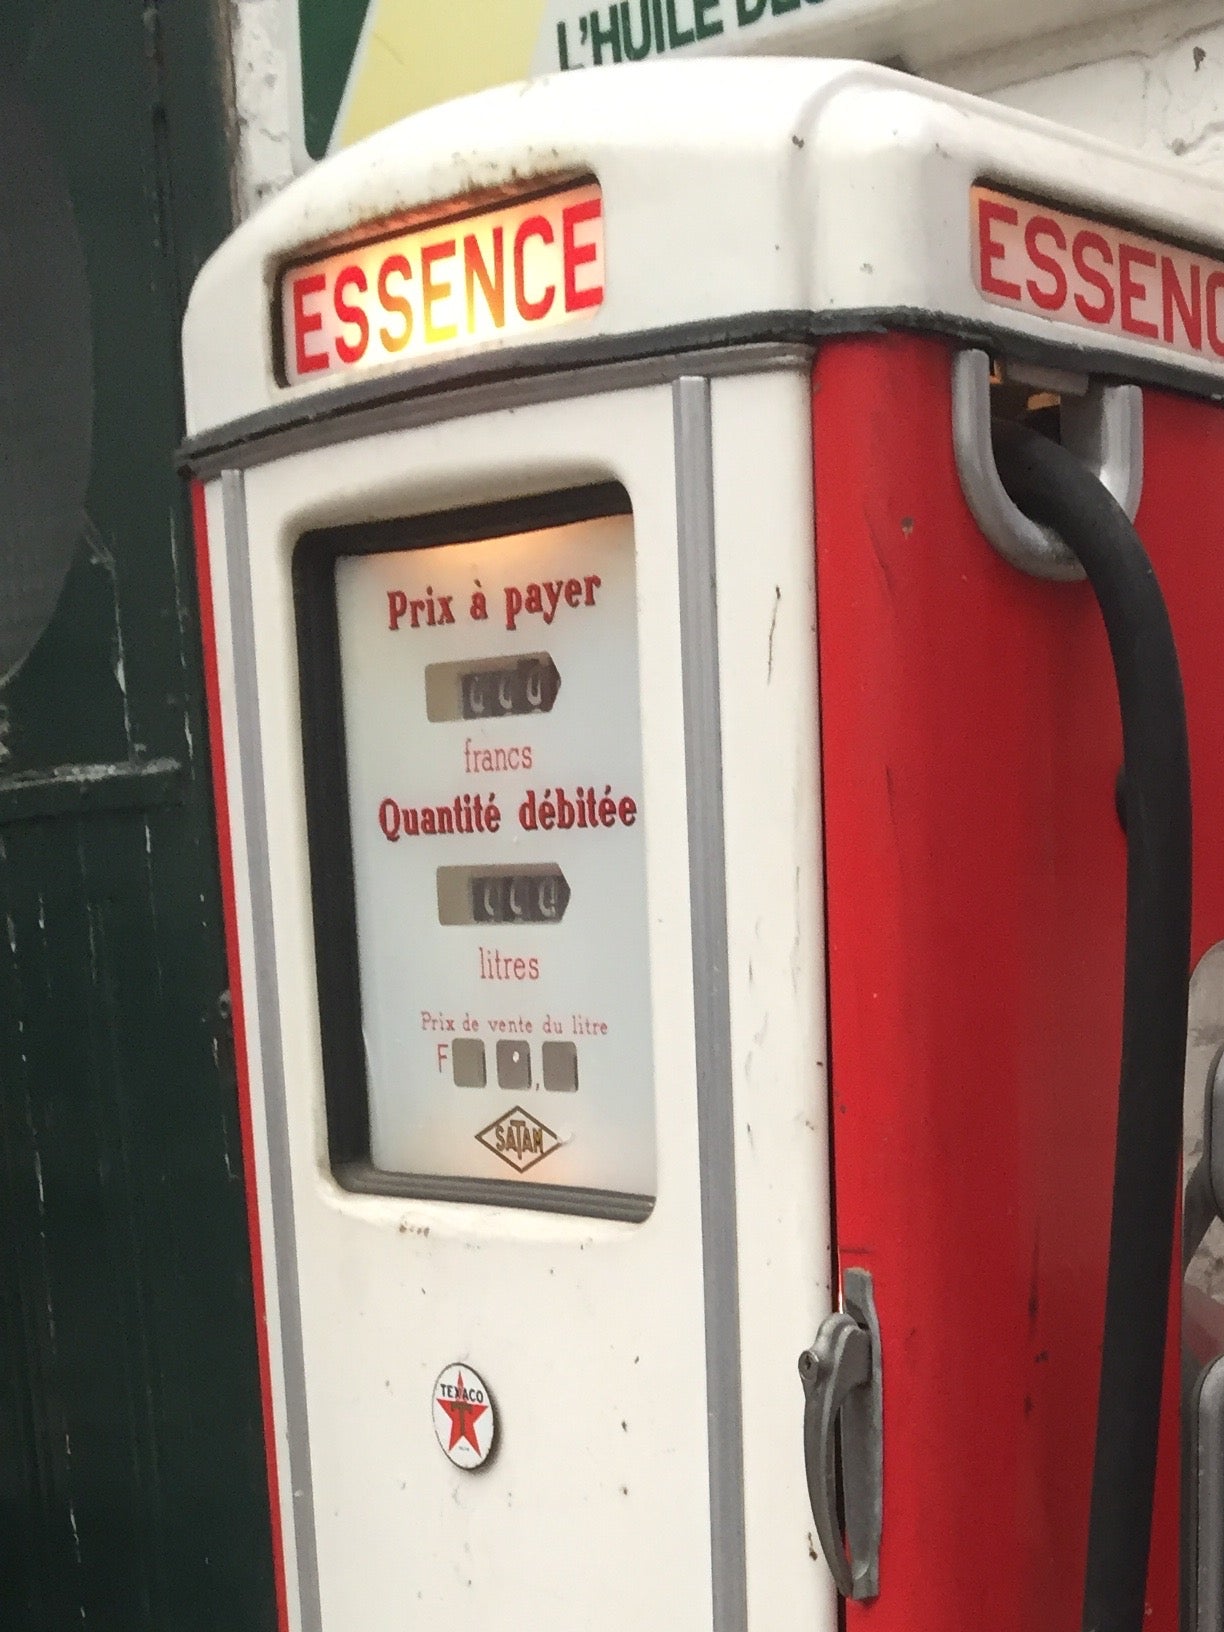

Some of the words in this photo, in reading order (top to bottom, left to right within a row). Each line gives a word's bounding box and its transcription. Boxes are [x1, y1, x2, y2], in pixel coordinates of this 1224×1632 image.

[556, 0, 723, 72] L'HUILE
[292, 198, 604, 375] ESSENCE
[387, 585, 455, 631] Prix
[470, 578, 488, 621] à
[504, 574, 602, 631] payer
[464, 738, 533, 773] francs
[378, 792, 501, 842] Quantité
[518, 784, 637, 831] débitée
[479, 947, 540, 980] litres
[421, 1011, 455, 1031] Prix
[462, 1013, 479, 1032] de
[488, 1015, 533, 1034] vente
[542, 1014, 563, 1034] du
[572, 1014, 608, 1036] litre
[495, 1120, 545, 1160] SATAM
[440, 1383, 484, 1403] TEXACO
